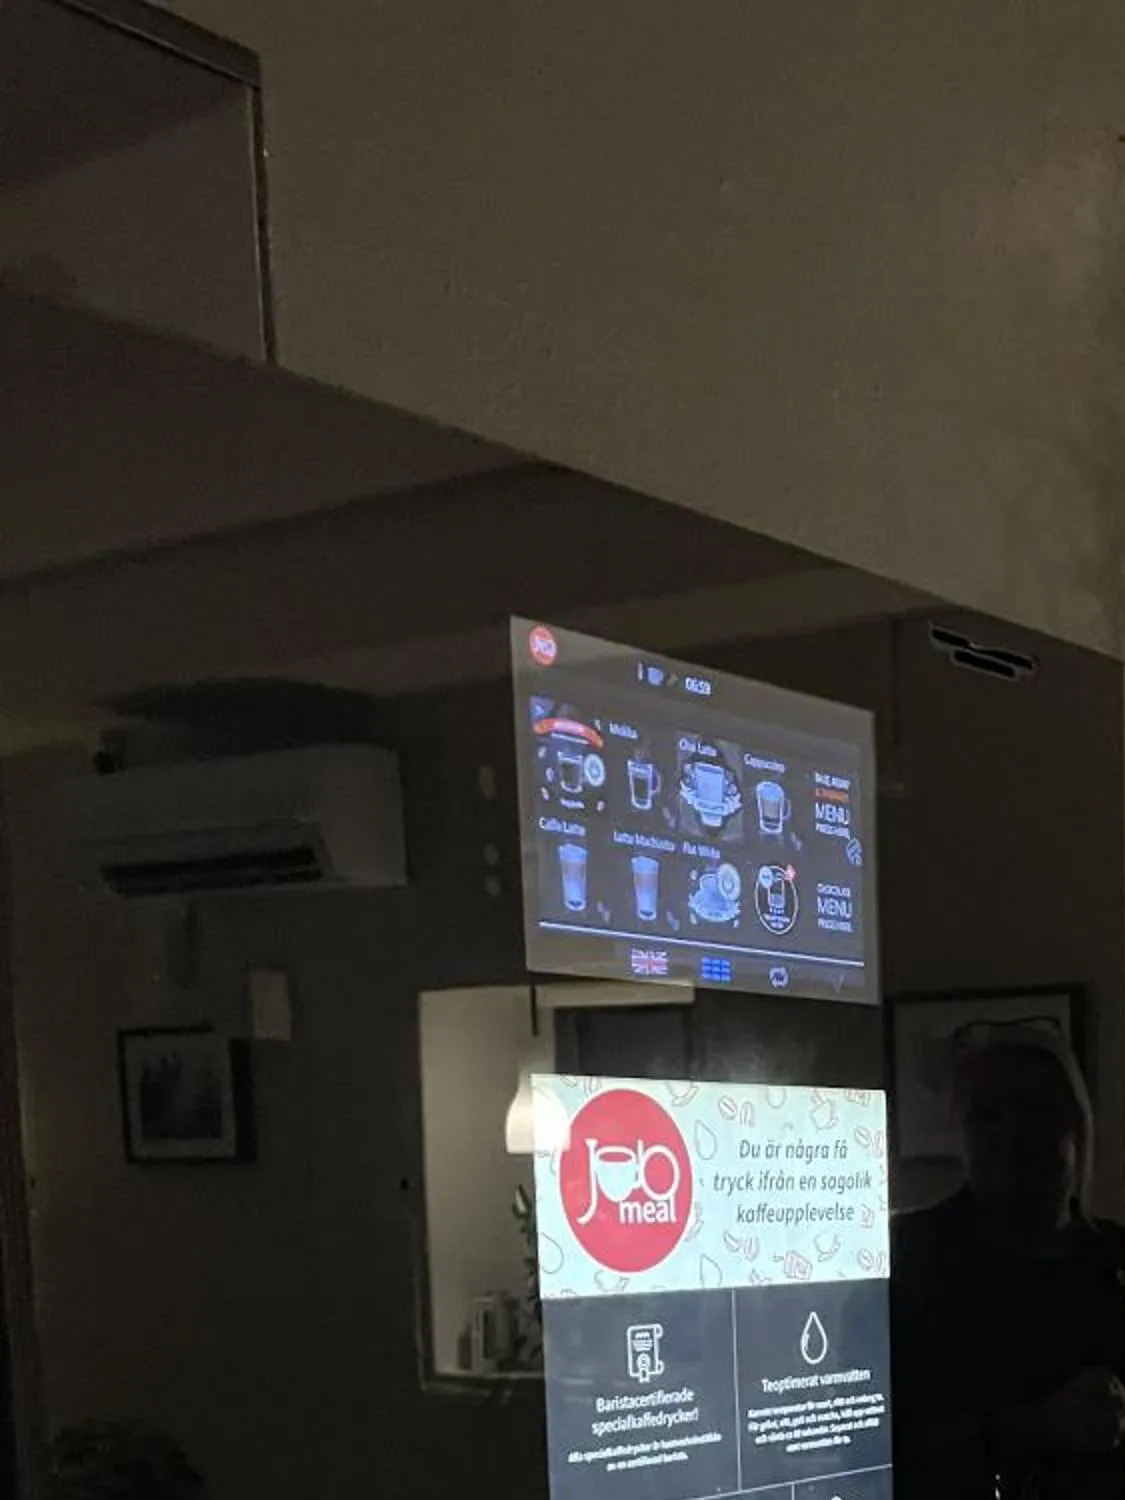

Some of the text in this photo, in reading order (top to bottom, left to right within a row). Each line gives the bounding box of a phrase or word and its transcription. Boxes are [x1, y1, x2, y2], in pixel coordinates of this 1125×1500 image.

[815, 802, 850, 826] MENU
[816, 896, 854, 919] MENU
[739, 1138, 849, 1164] Du är några få
[713, 1169, 872, 1197] tryck ifrån en sagolik
[620, 1195, 677, 1224] meal
[736, 1201, 855, 1226] kaffeupplevelse
